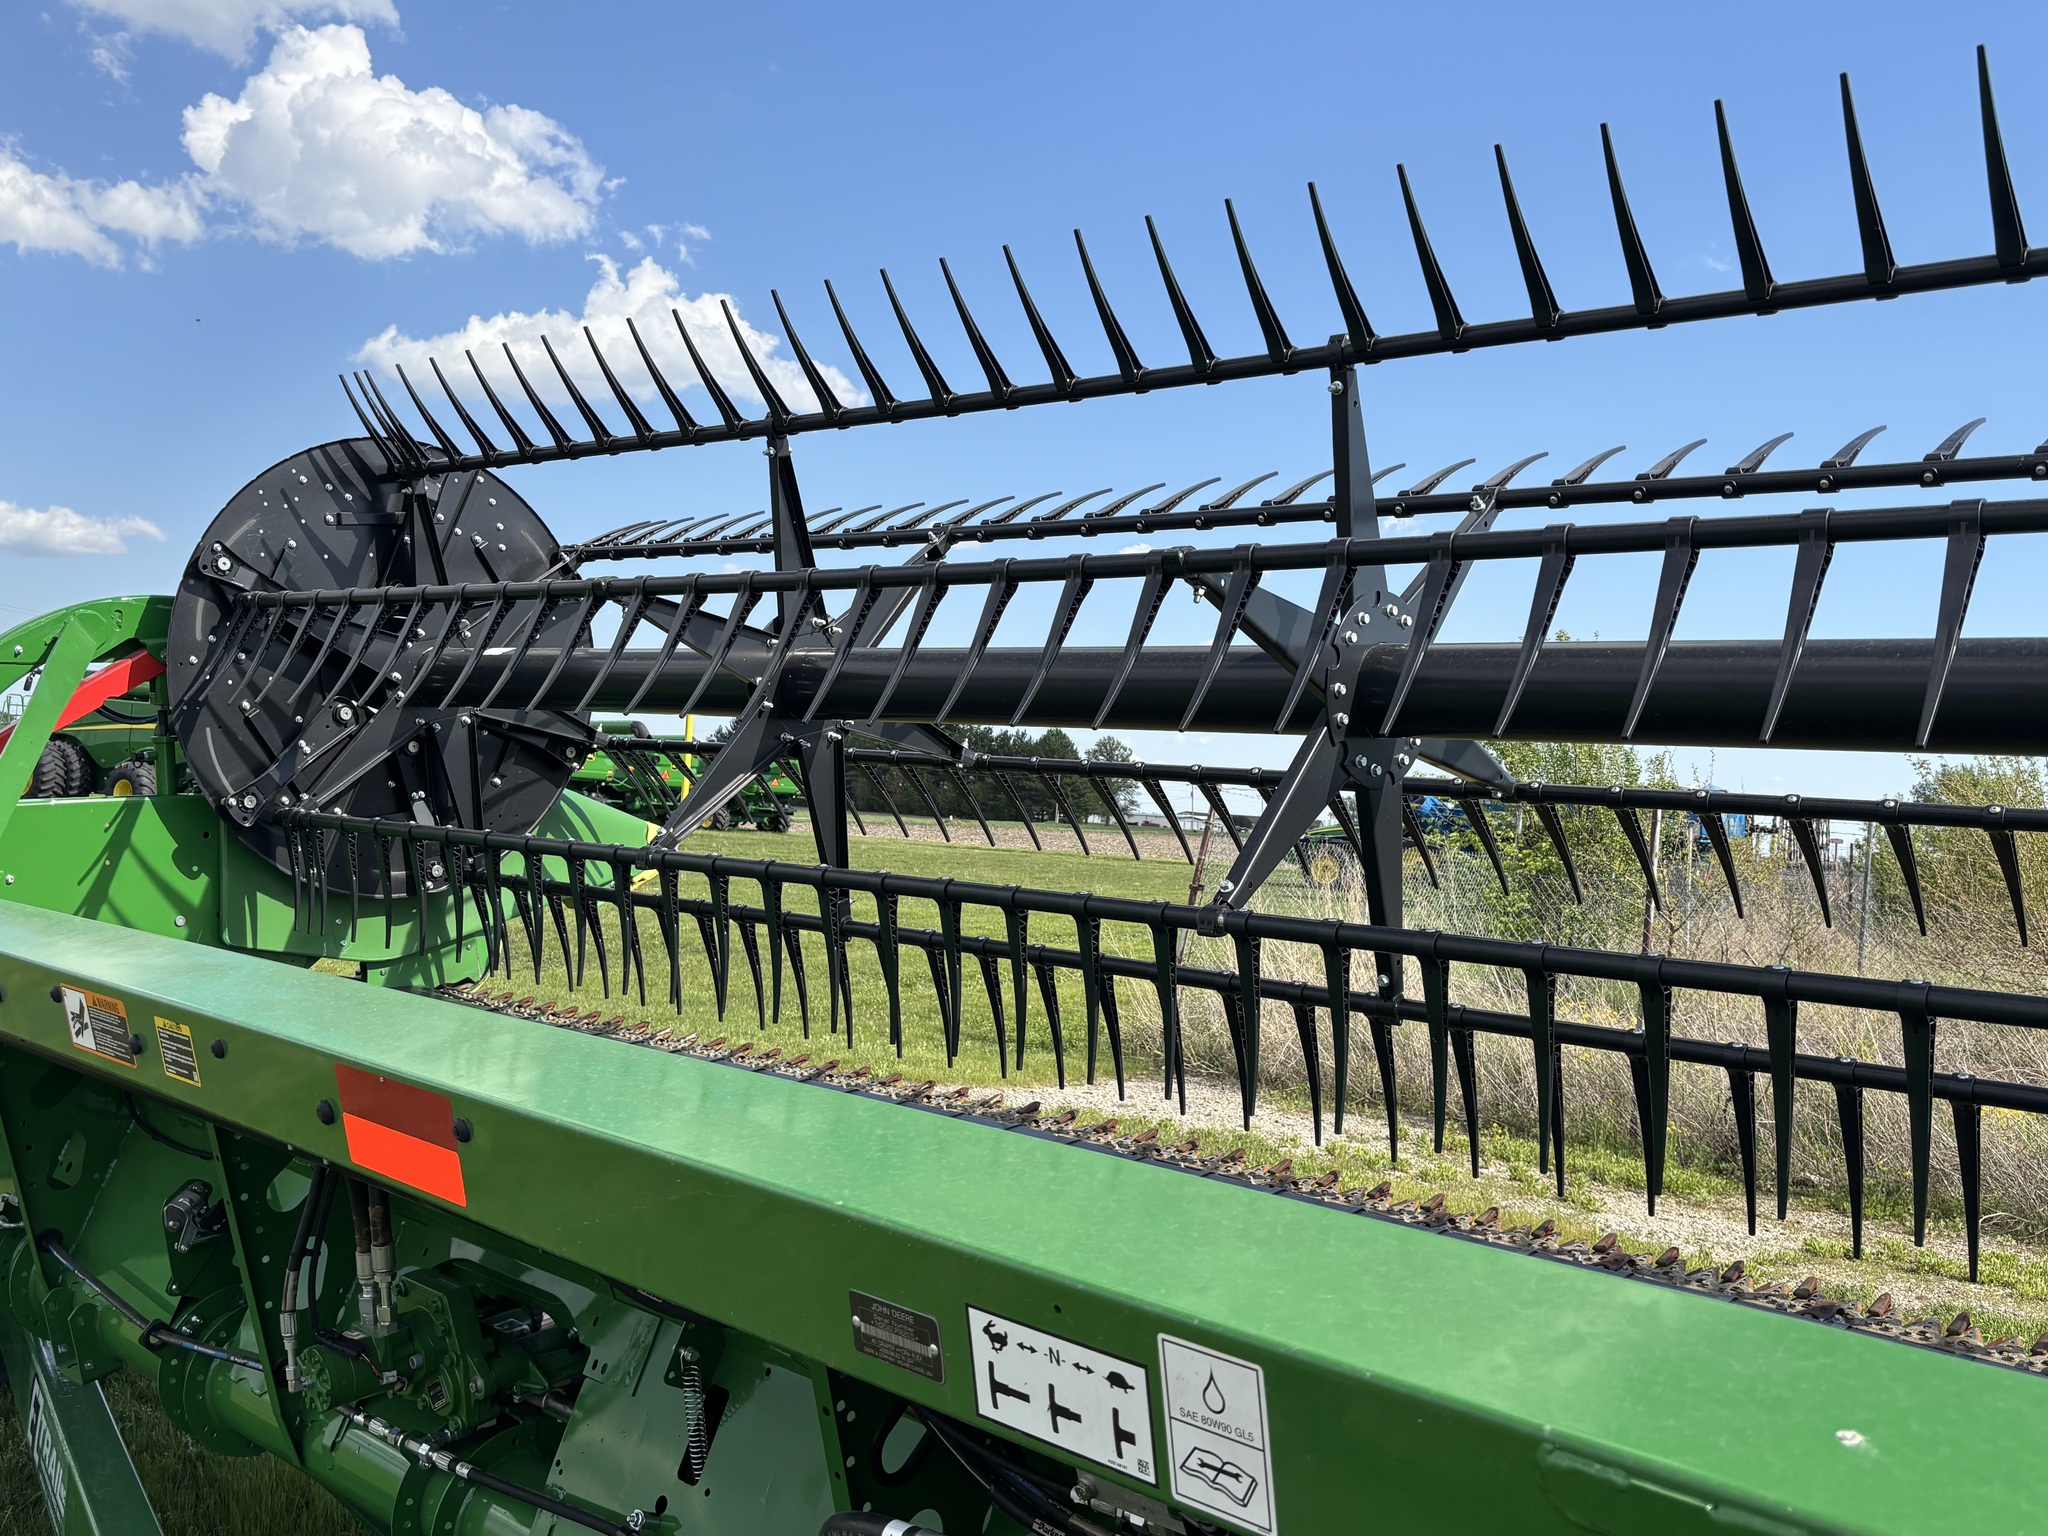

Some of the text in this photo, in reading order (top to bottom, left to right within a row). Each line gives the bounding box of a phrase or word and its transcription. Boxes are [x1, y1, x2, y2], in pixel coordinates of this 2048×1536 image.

[871, 1303, 915, 1325] JOHN DEERE
[873, 1313, 890, 1324] Serial
[891, 1320, 915, 1332] Number
[1179, 1407, 1254, 1442] SAE 80W90 GL5
